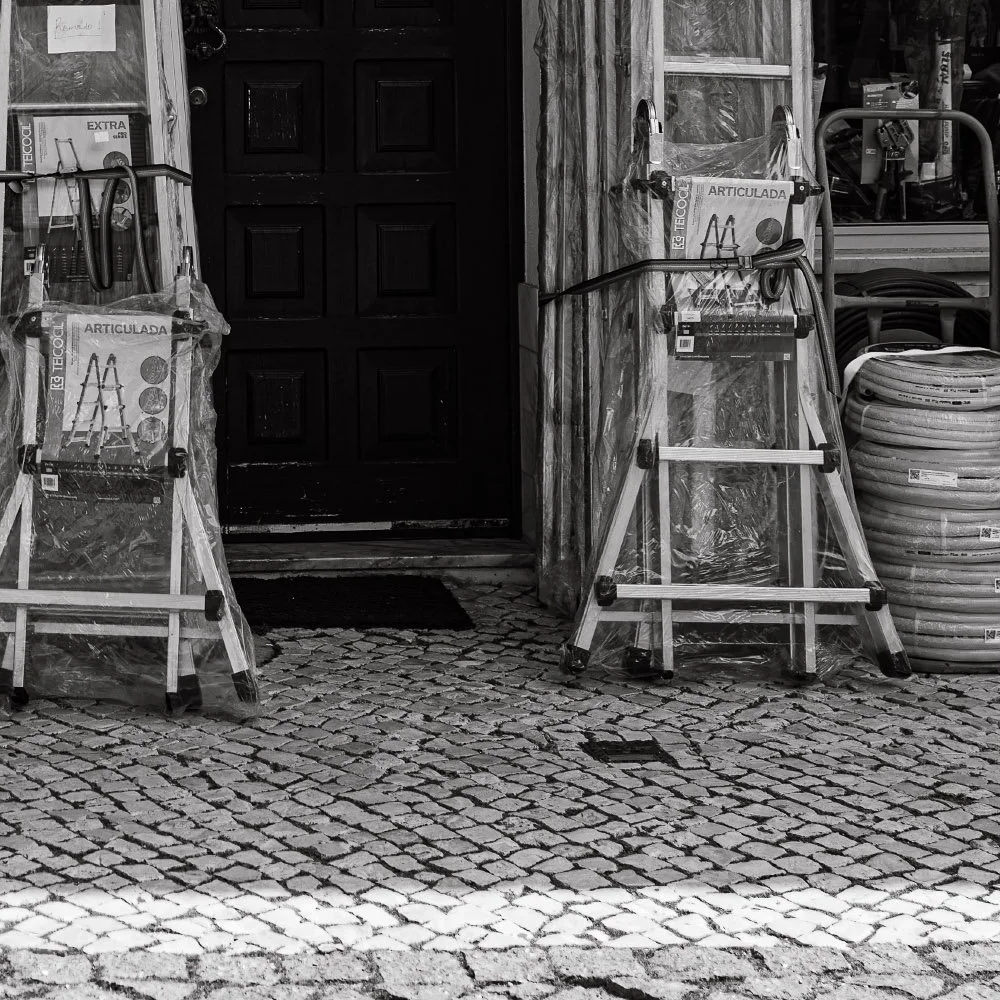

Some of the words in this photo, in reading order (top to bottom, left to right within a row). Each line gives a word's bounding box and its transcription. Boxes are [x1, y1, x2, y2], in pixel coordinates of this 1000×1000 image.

[87, 121, 127, 131] EXTRA
[708, 185, 787, 199] ARTICULADA
[84, 323, 168, 335] ARTICULADA
